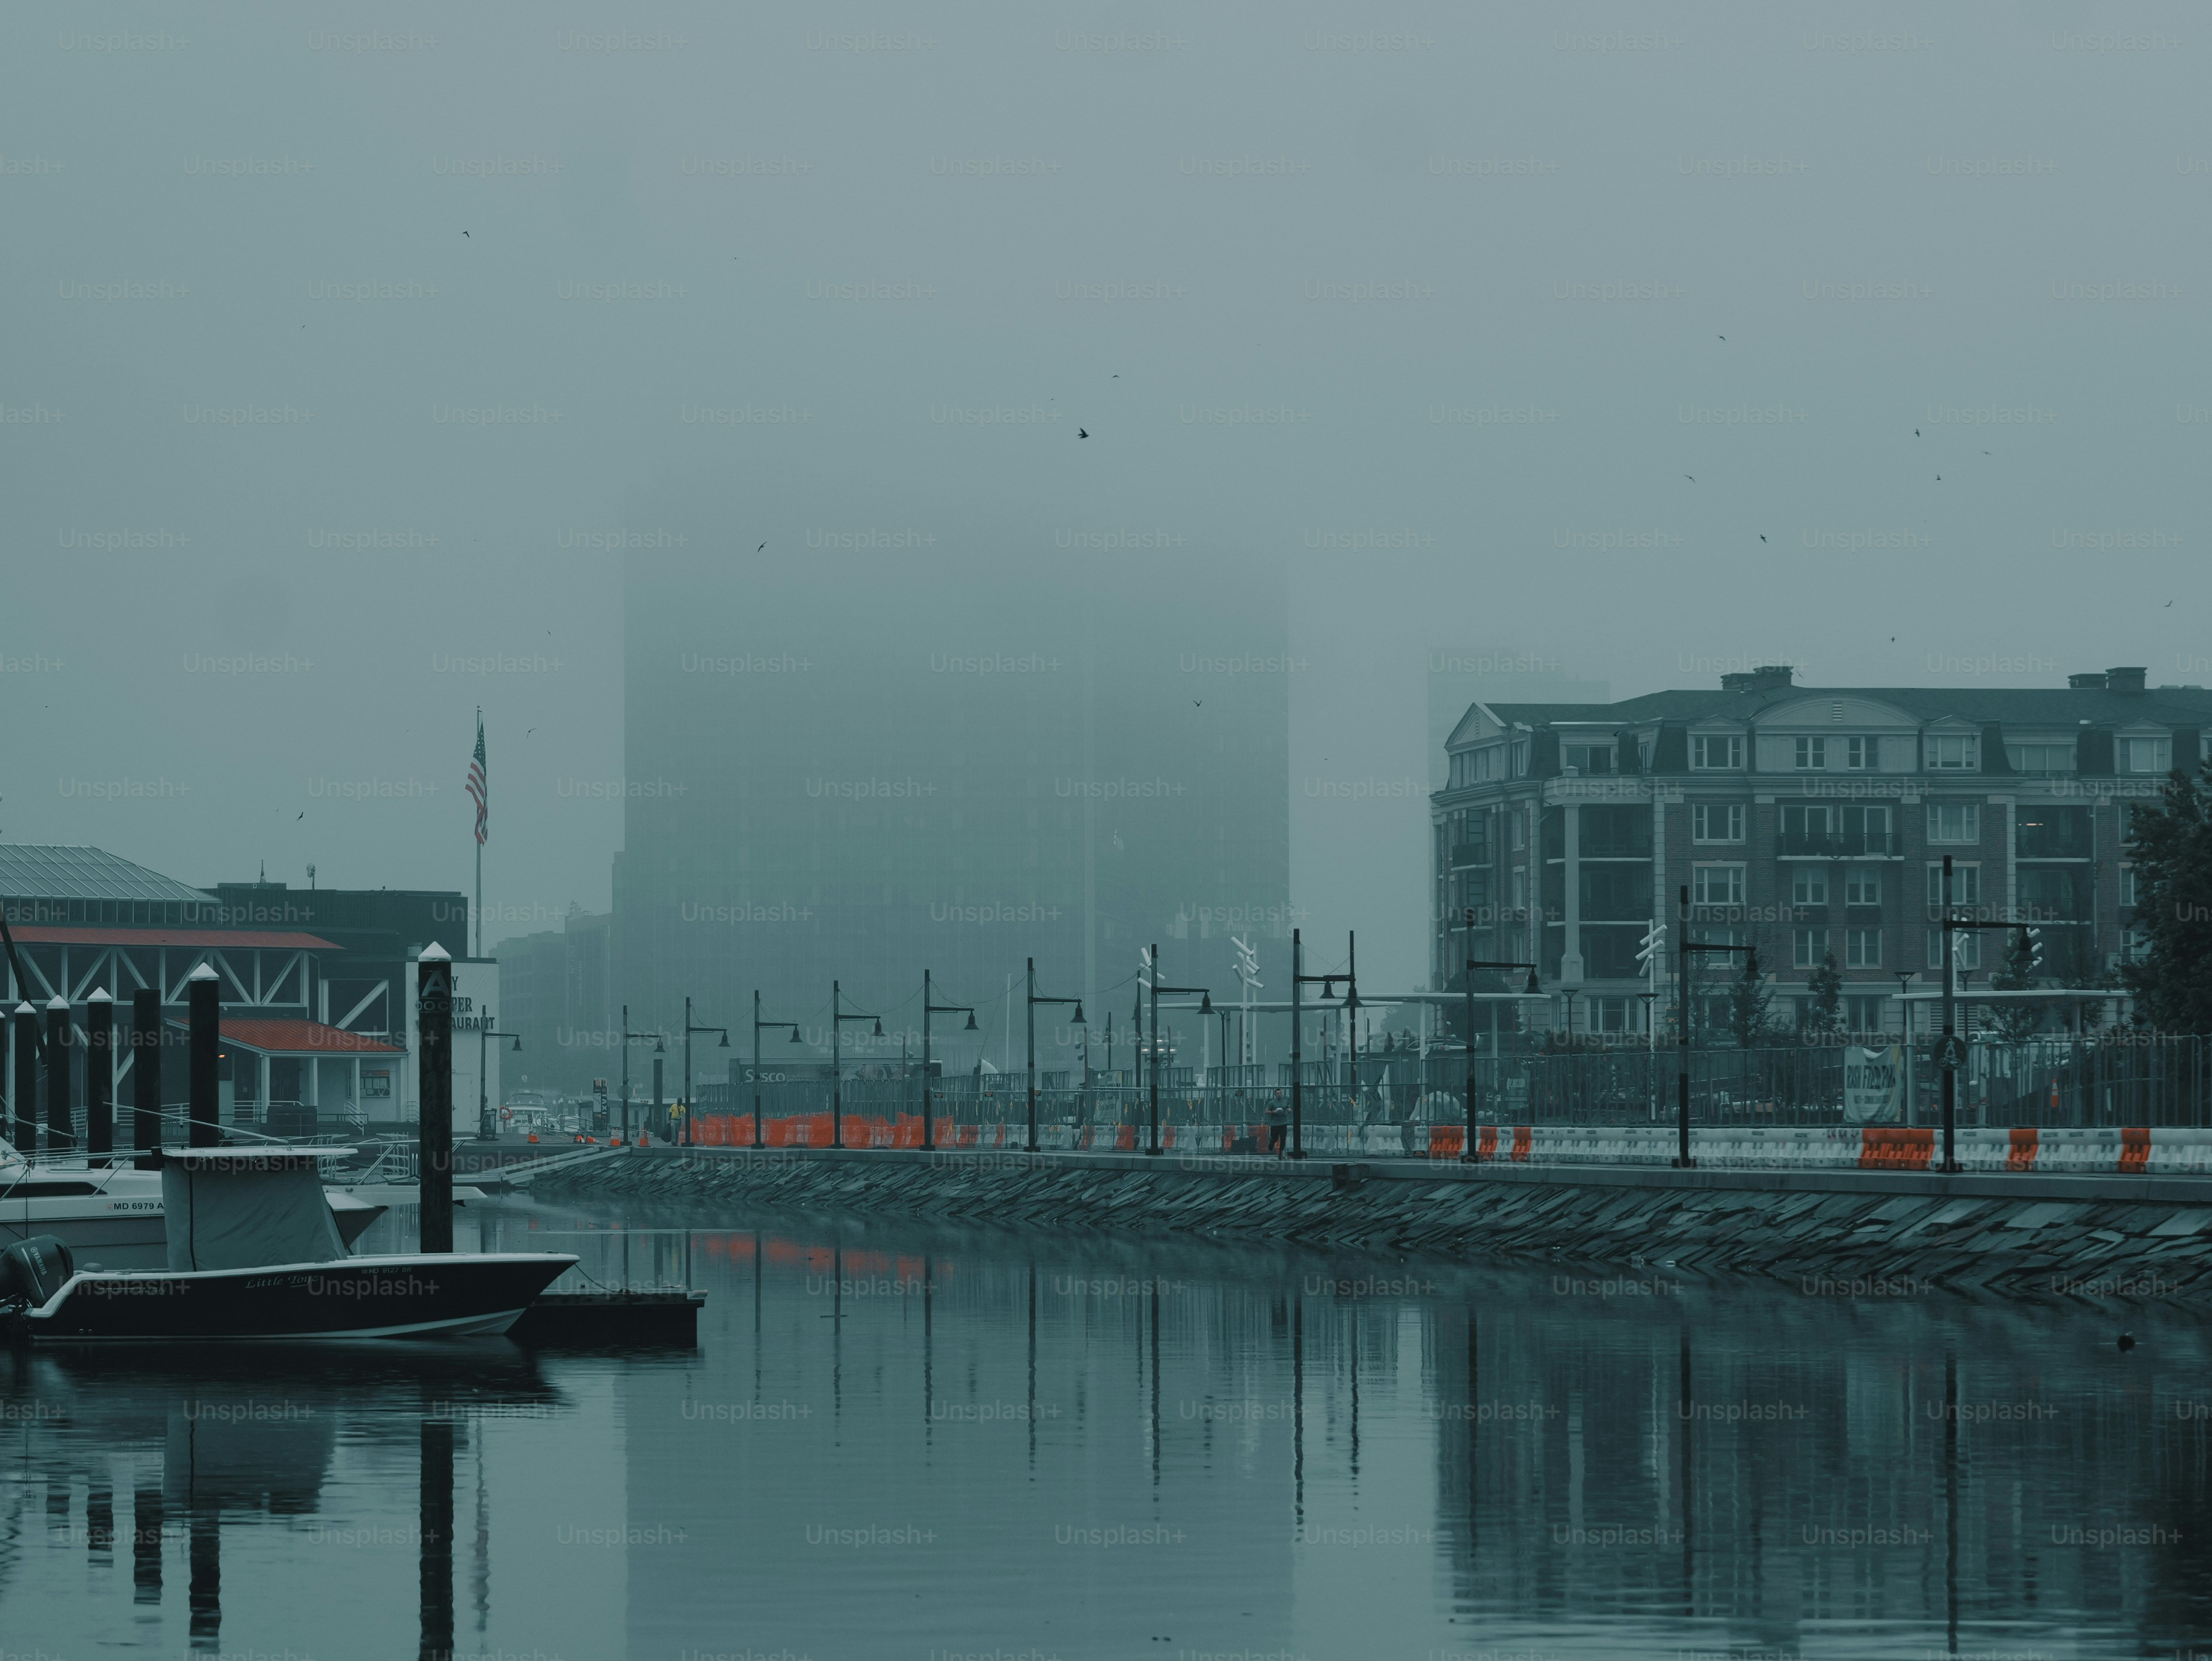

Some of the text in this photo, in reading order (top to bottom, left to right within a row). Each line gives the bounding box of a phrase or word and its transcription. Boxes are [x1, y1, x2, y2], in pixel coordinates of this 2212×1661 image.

[421, 970, 450, 997] A
[745, 1068, 786, 1082] Ssco
[33, 1252, 47, 1276] YAMAHA
[244, 1275, 320, 1288] Little Toyz
